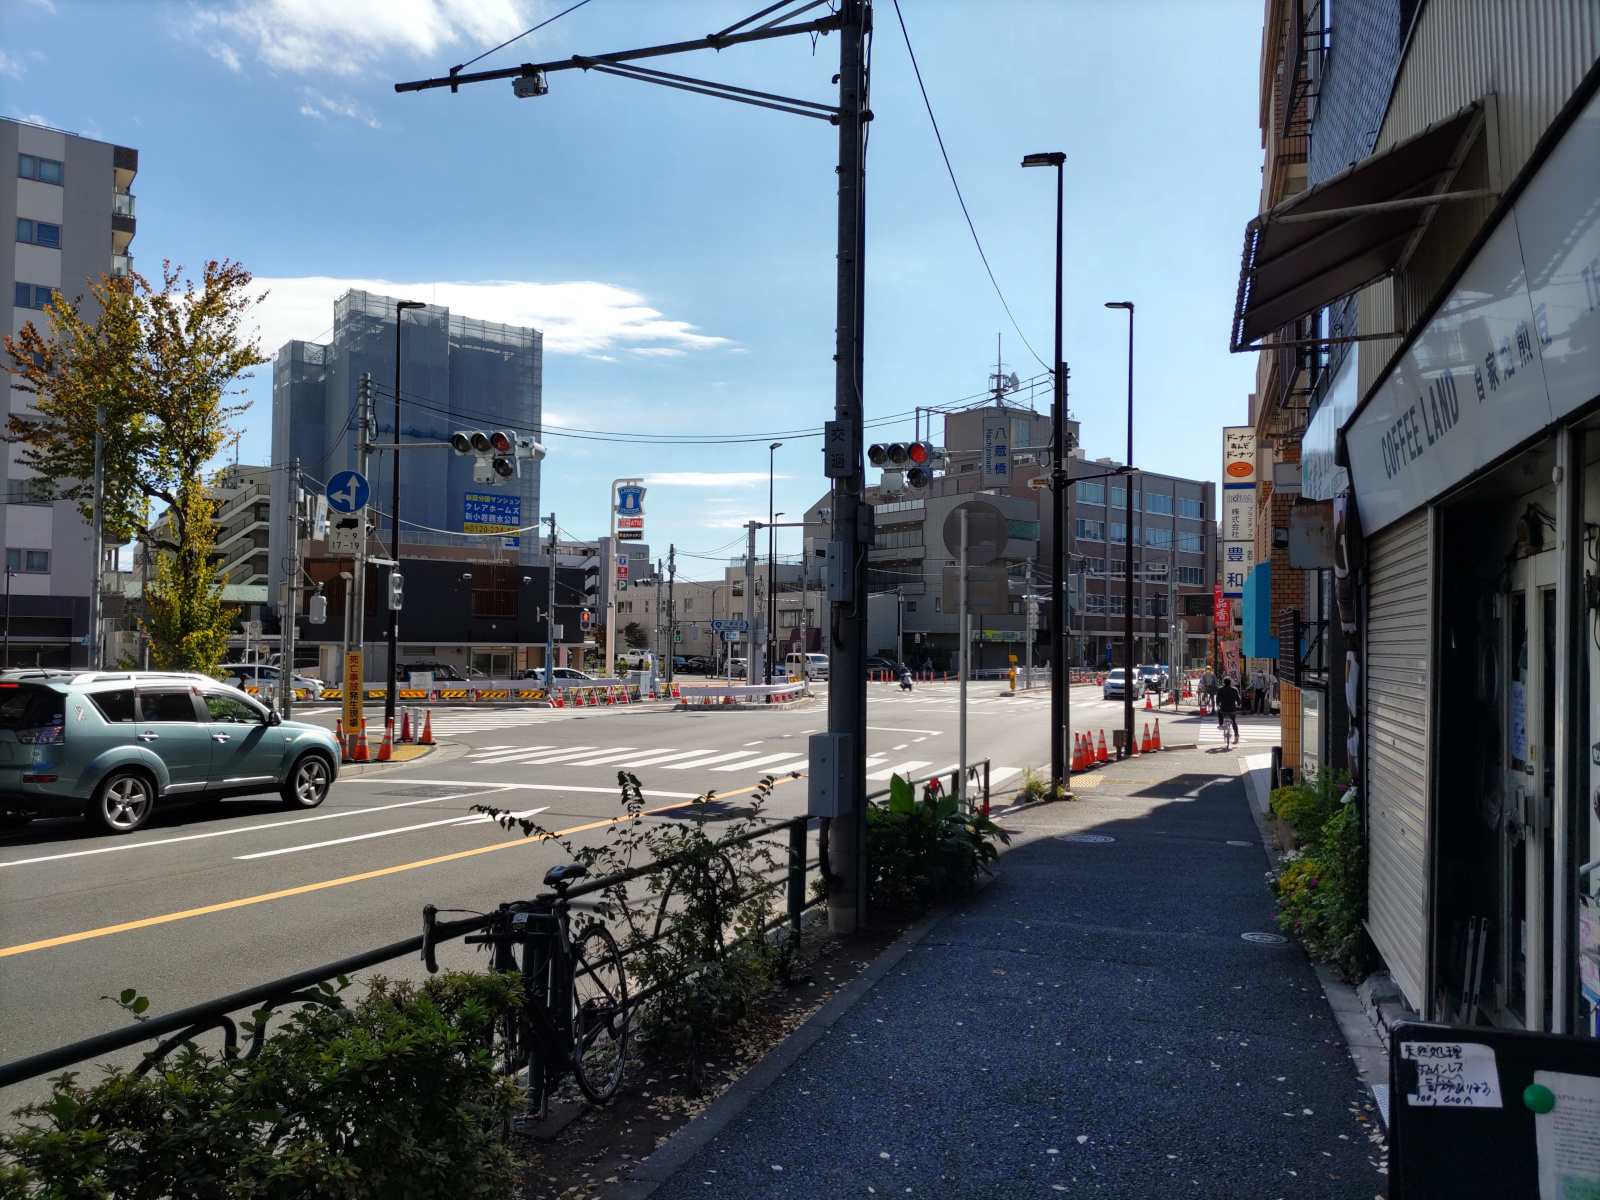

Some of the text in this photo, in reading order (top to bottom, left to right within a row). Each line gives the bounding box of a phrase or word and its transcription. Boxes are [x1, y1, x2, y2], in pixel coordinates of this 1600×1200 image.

[1381, 404, 1424, 480] COFFEE
[1420, 368, 1459, 447] LAND
[1227, 433, 1254, 442] ドーナツ
[831, 428, 845, 468] 交通
[994, 427, 1007, 475] 八蔵橋
[1231, 442, 1250, 450] あんど
[1227, 451, 1254, 459] ドーナツ
[465, 503, 520, 515] クレアホームズ
[465, 512, 519, 524] 新小岩親水公園
[630, 519, 642, 527] ATM
[1231, 508, 1240, 539] 株式会社
[1227, 547, 1244, 588] 豊和
[619, 580, 626, 590] P
[349, 655, 359, 727] 死亡事故発生現場
[1405, 1044, 1462, 1059] 天然処理
